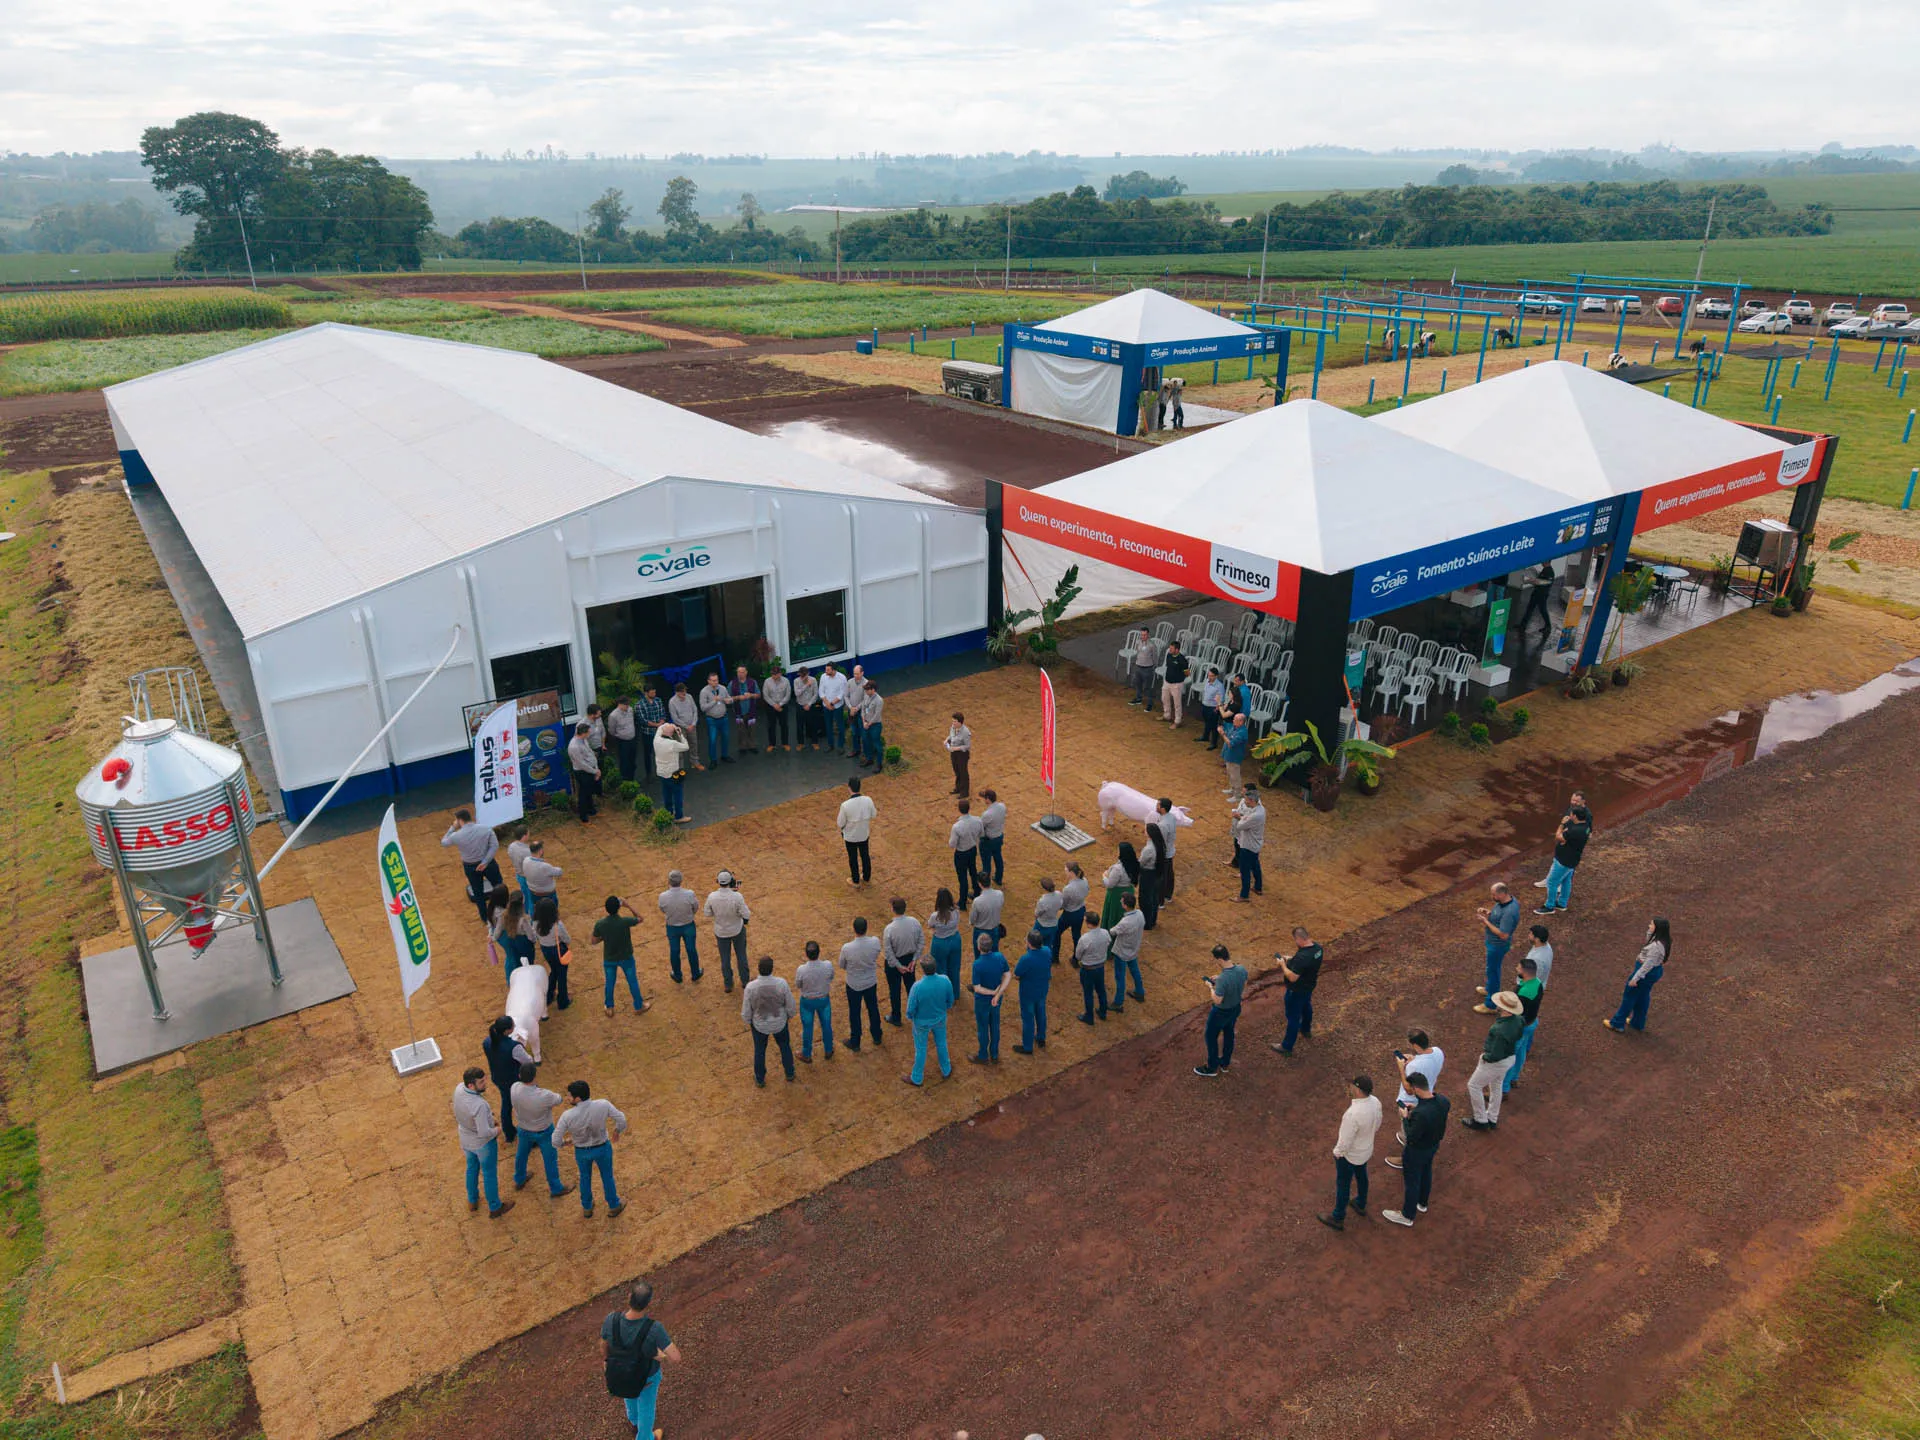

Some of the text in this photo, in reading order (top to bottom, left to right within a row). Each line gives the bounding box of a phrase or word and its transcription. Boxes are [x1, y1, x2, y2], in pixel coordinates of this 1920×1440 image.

[1033, 335, 1069, 347] Produção Animal
[1173, 344, 1218, 356] Produção Animal
[1781, 457, 1809, 474] Frimesa
[1654, 469, 1767, 515] Quem experimenta, recomenda.
[1019, 505, 1188, 568] Quem experimenta, recomenda.
[1417, 535, 1535, 580] Fomento Suínos e Leite
[1215, 558, 1271, 590] Frimesa
[517, 703, 549, 716] ultura
